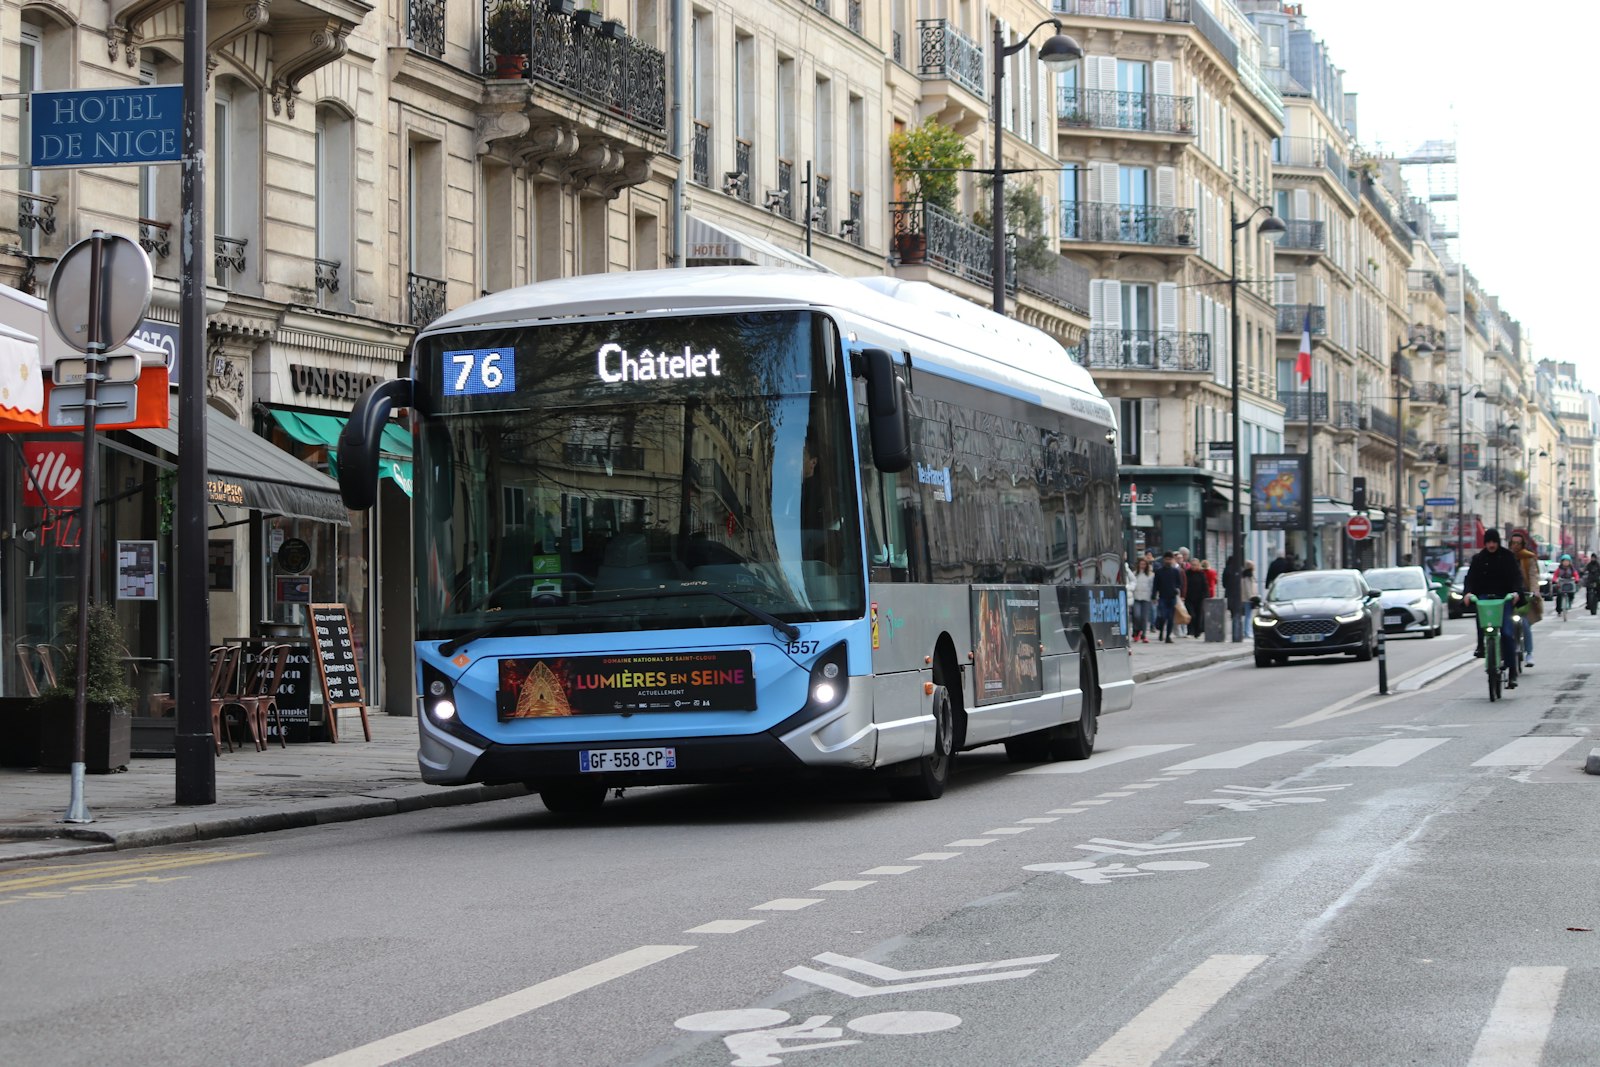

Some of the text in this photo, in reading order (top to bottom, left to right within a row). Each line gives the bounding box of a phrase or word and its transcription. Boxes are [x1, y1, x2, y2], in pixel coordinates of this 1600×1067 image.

[52, 94, 163, 124] HOTEL
[40, 129, 176, 160] DE NICE
[694, 244, 729, 256] HOTEL
[452, 352, 504, 391] 76
[598, 343, 721, 383] Châtelet
[27, 451, 82, 500] illy
[286, 654, 310, 664] box
[633, 655, 664, 663] NATIONAL
[675, 654, 717, 662] SAINT-CLOUD
[785, 640, 820, 655] 1557
[577, 669, 744, 690] LUMIÈRES EN SEINE
